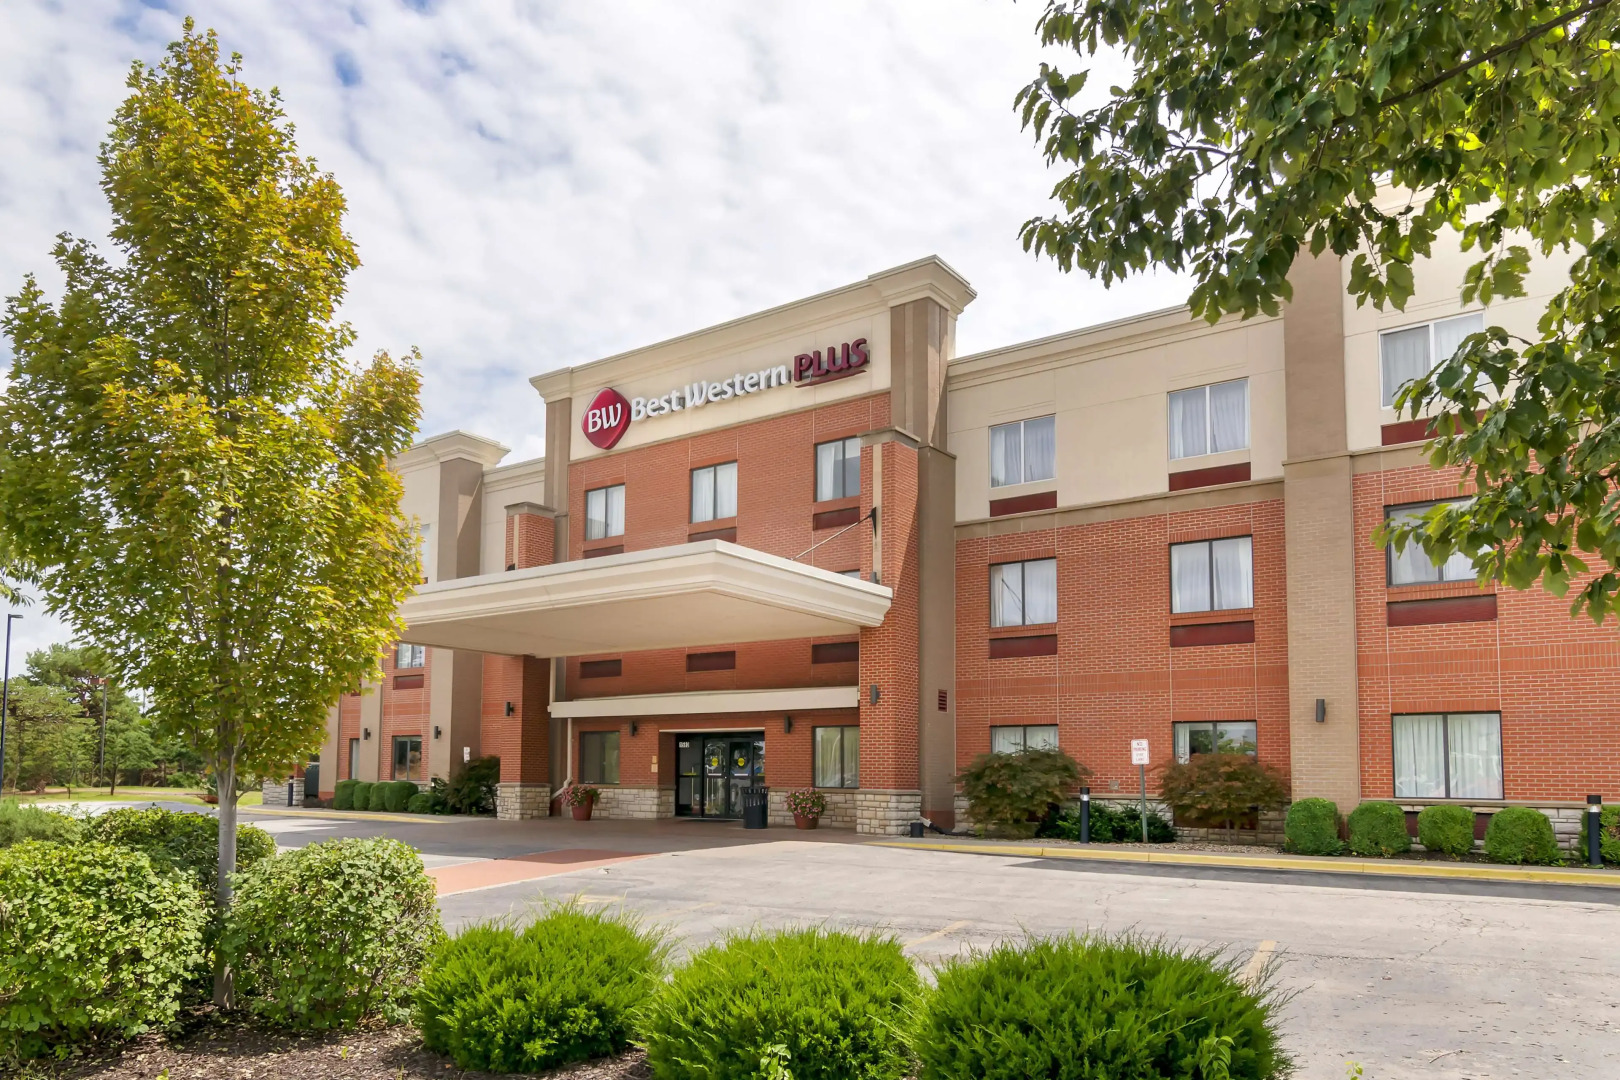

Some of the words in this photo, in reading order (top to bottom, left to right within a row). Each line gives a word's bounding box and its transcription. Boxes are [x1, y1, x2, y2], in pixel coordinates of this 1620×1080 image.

[631, 395, 682, 421] Best
[684, 365, 788, 407] Western
[794, 338, 868, 382] PLUS
[587, 403, 622, 433] BW
